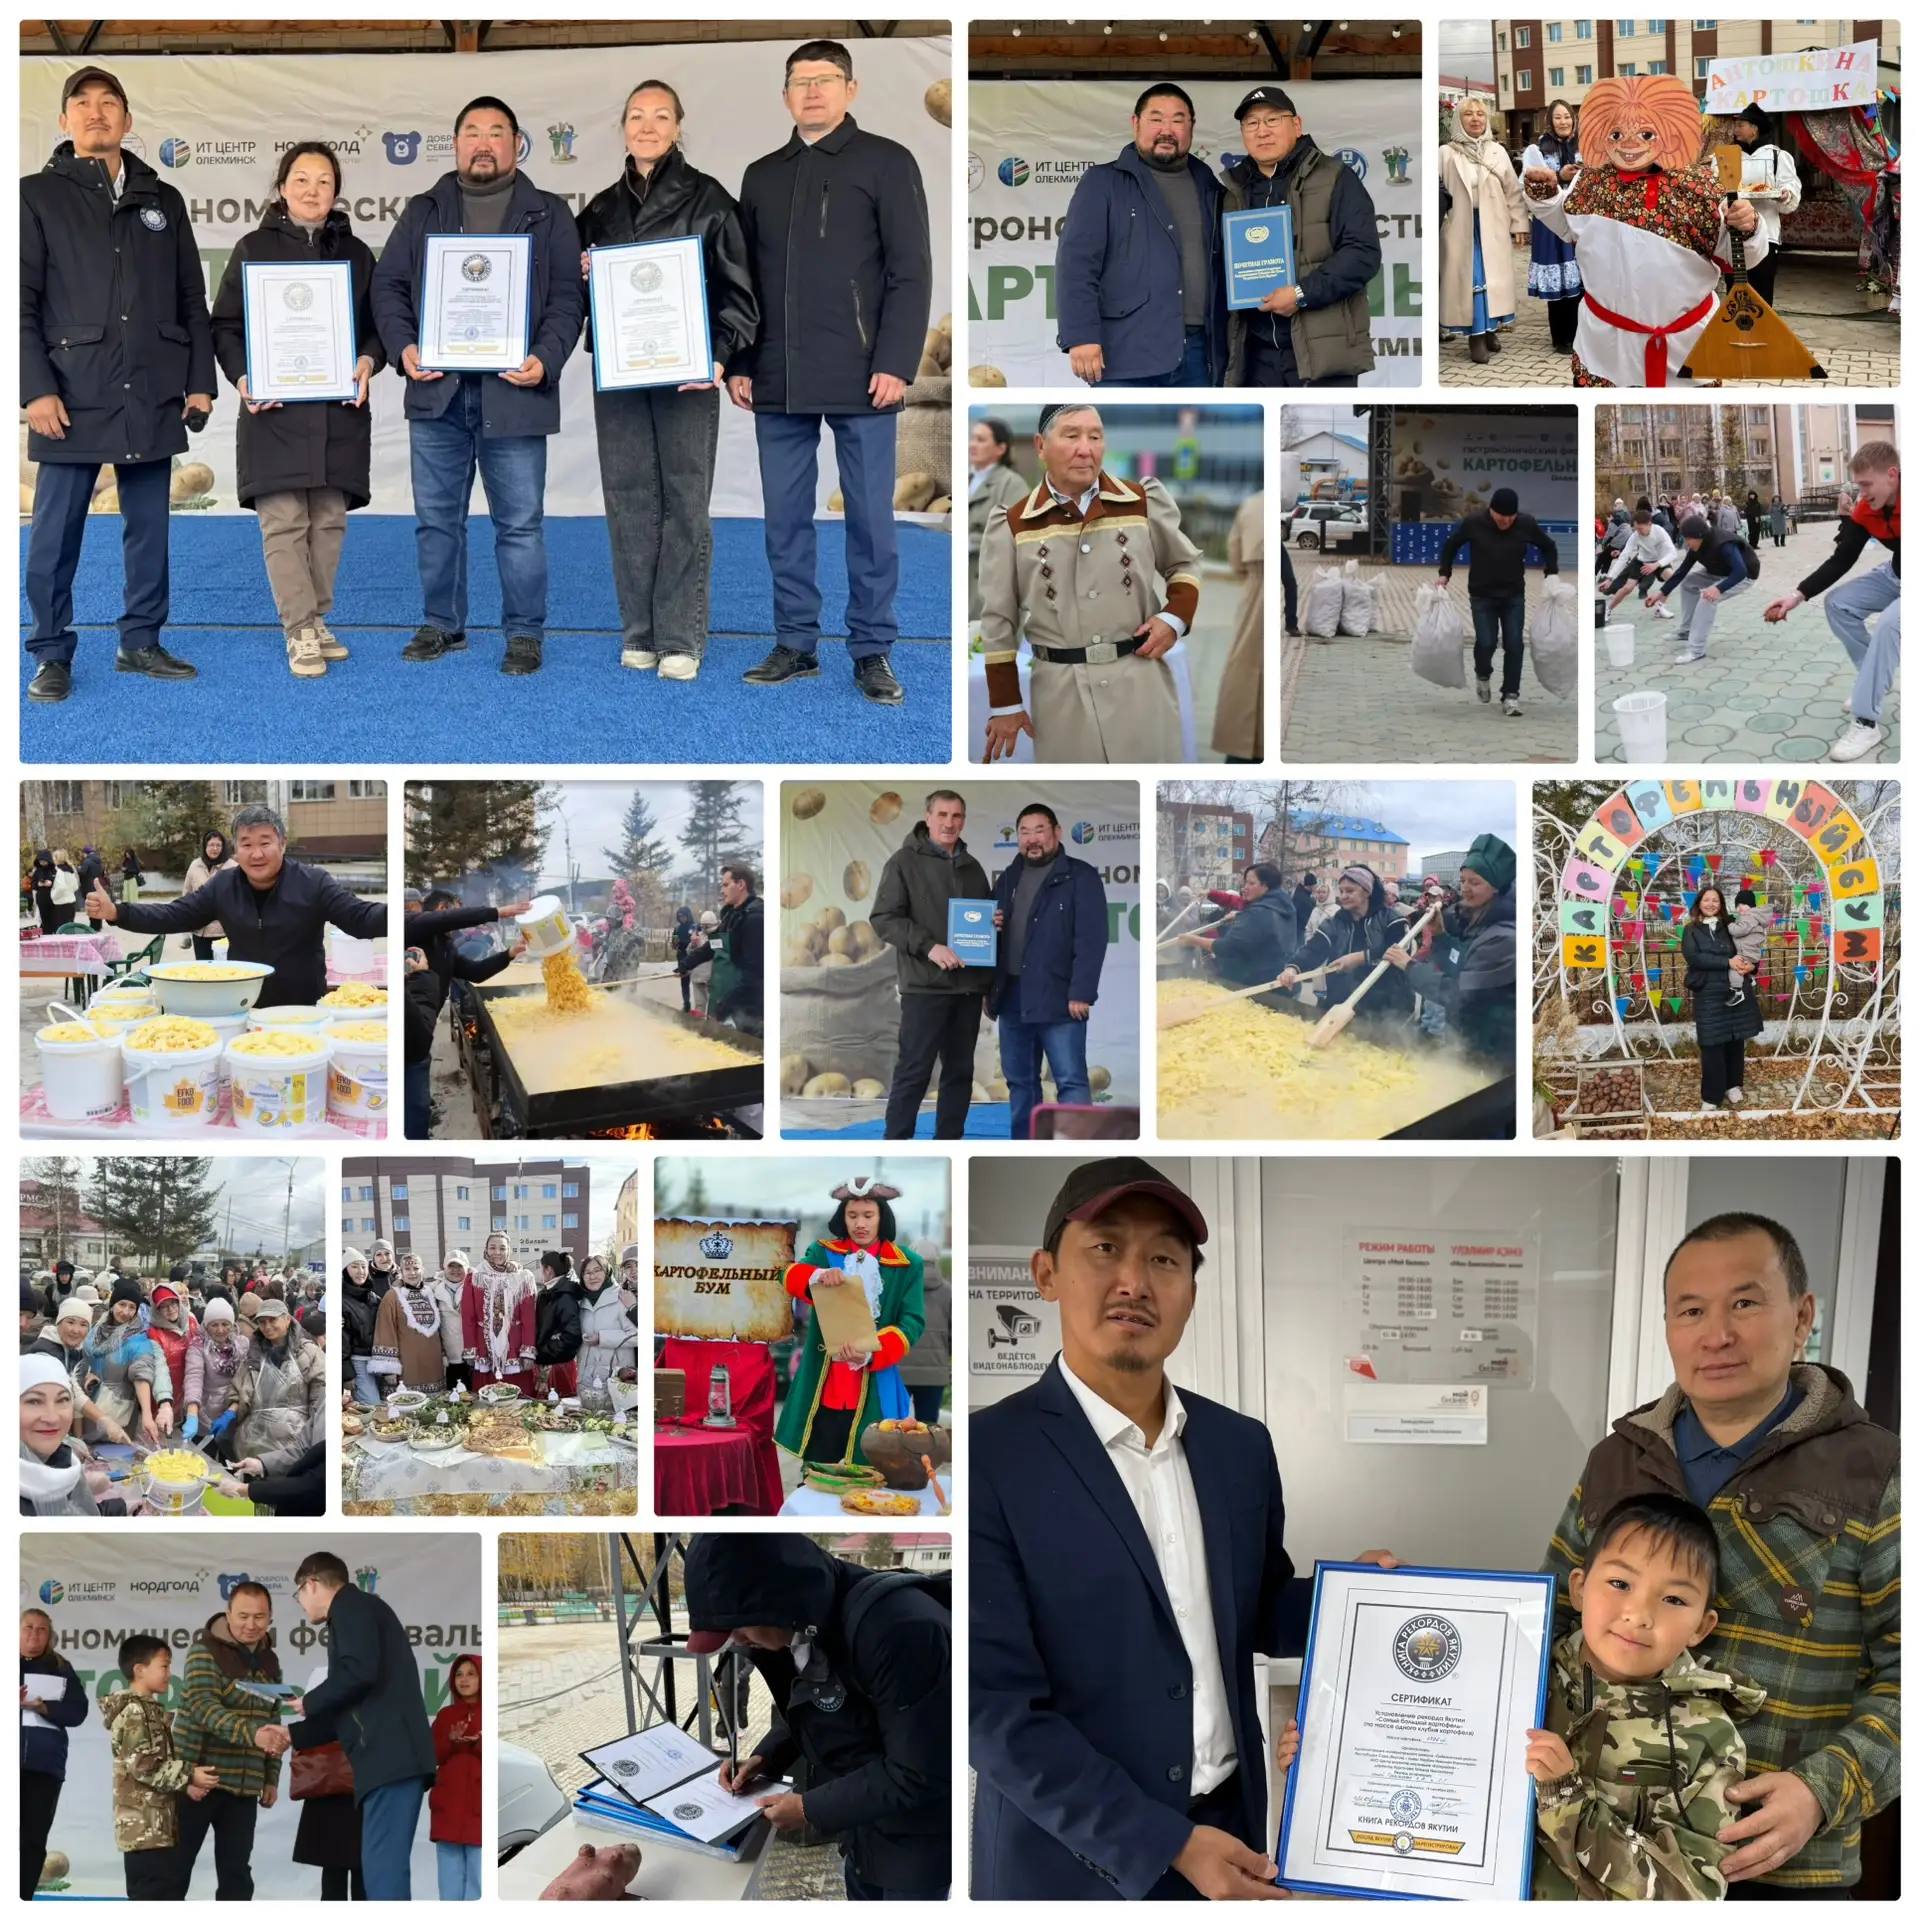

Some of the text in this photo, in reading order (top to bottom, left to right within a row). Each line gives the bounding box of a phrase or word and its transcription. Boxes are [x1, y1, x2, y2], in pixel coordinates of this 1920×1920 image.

[1711, 51, 1872, 91] АНТОШКИНА
[1715, 79, 1870, 109] КАРТОШКА
[196, 141, 257, 154] ИТ ЦЕНТР
[195, 156, 257, 166] ОЛЕКМИНСК
[1035, 161, 1052, 172] ИТ
[1463, 457, 1577, 472] КАРТОФЕЛЬН
[1098, 824, 1111, 833] ИТ
[177, 1097, 195, 1106] FOOD
[1359, 1242, 1435, 1254] РЕЖИМ РАБОТЫ
[654, 1264, 782, 1282] КАРТОФЕЛЬНЫЙ
[694, 1281, 731, 1295] БУМ
[969, 1289, 1044, 1301] НА ТЕРРИТОР
[68, 1582, 116, 1593] ИТ ЦЕНТР
[67, 1594, 115, 1602] ОЛЕКМИНСК
[1397, 1618, 1458, 1677] КНИГА РЕКОРДОВ ЯКУТИИ
[1391, 1693, 1453, 1706] СЕРТИФИКАТ
[1374, 1710, 1466, 1723] Установление рекорда Якутии
[1395, 1724, 1417, 1732] одного
[1358, 1815, 1459, 1833] КНИГА РЕКОРДОВ ЯКУТИИ
